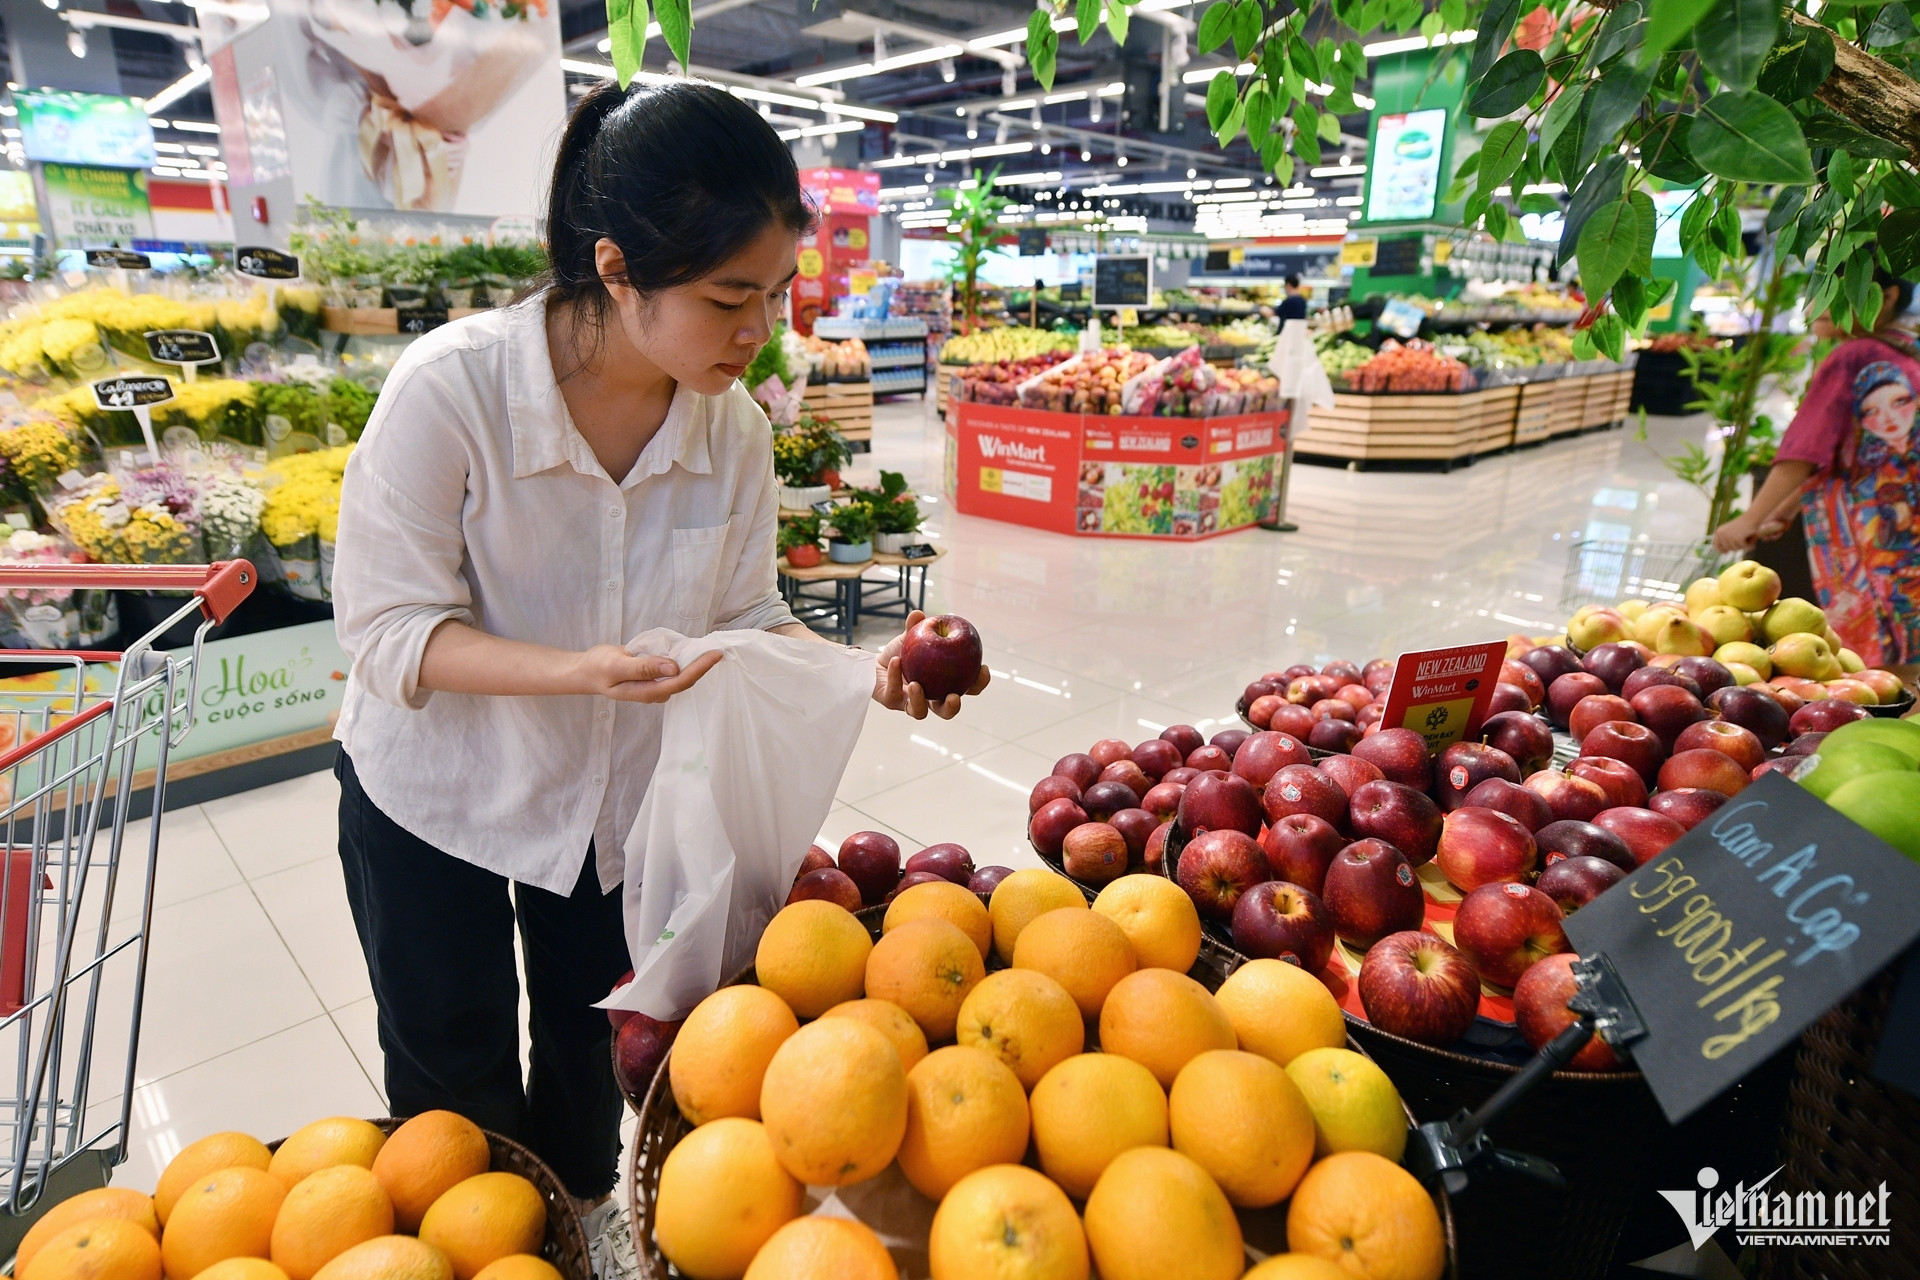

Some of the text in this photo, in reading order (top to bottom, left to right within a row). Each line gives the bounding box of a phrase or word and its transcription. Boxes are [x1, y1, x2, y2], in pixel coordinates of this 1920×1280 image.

[977, 433, 1046, 463] WinMart
[1420, 649, 1453, 659] DISCOVER
[1461, 646, 1480, 654] TASTE
[1416, 659, 1442, 677] NEW
[1441, 653, 1488, 673] ZEALAND
[201, 653, 294, 707] Hoa
[1412, 681, 1457, 699] WinMart
[207, 700, 265, 724] CUỘC
[273, 687, 327, 710] SỐNG
[1423, 730, 1456, 741] DEN BAY
[1427, 740, 1440, 749] UIT
[1710, 800, 1774, 868] Cam
